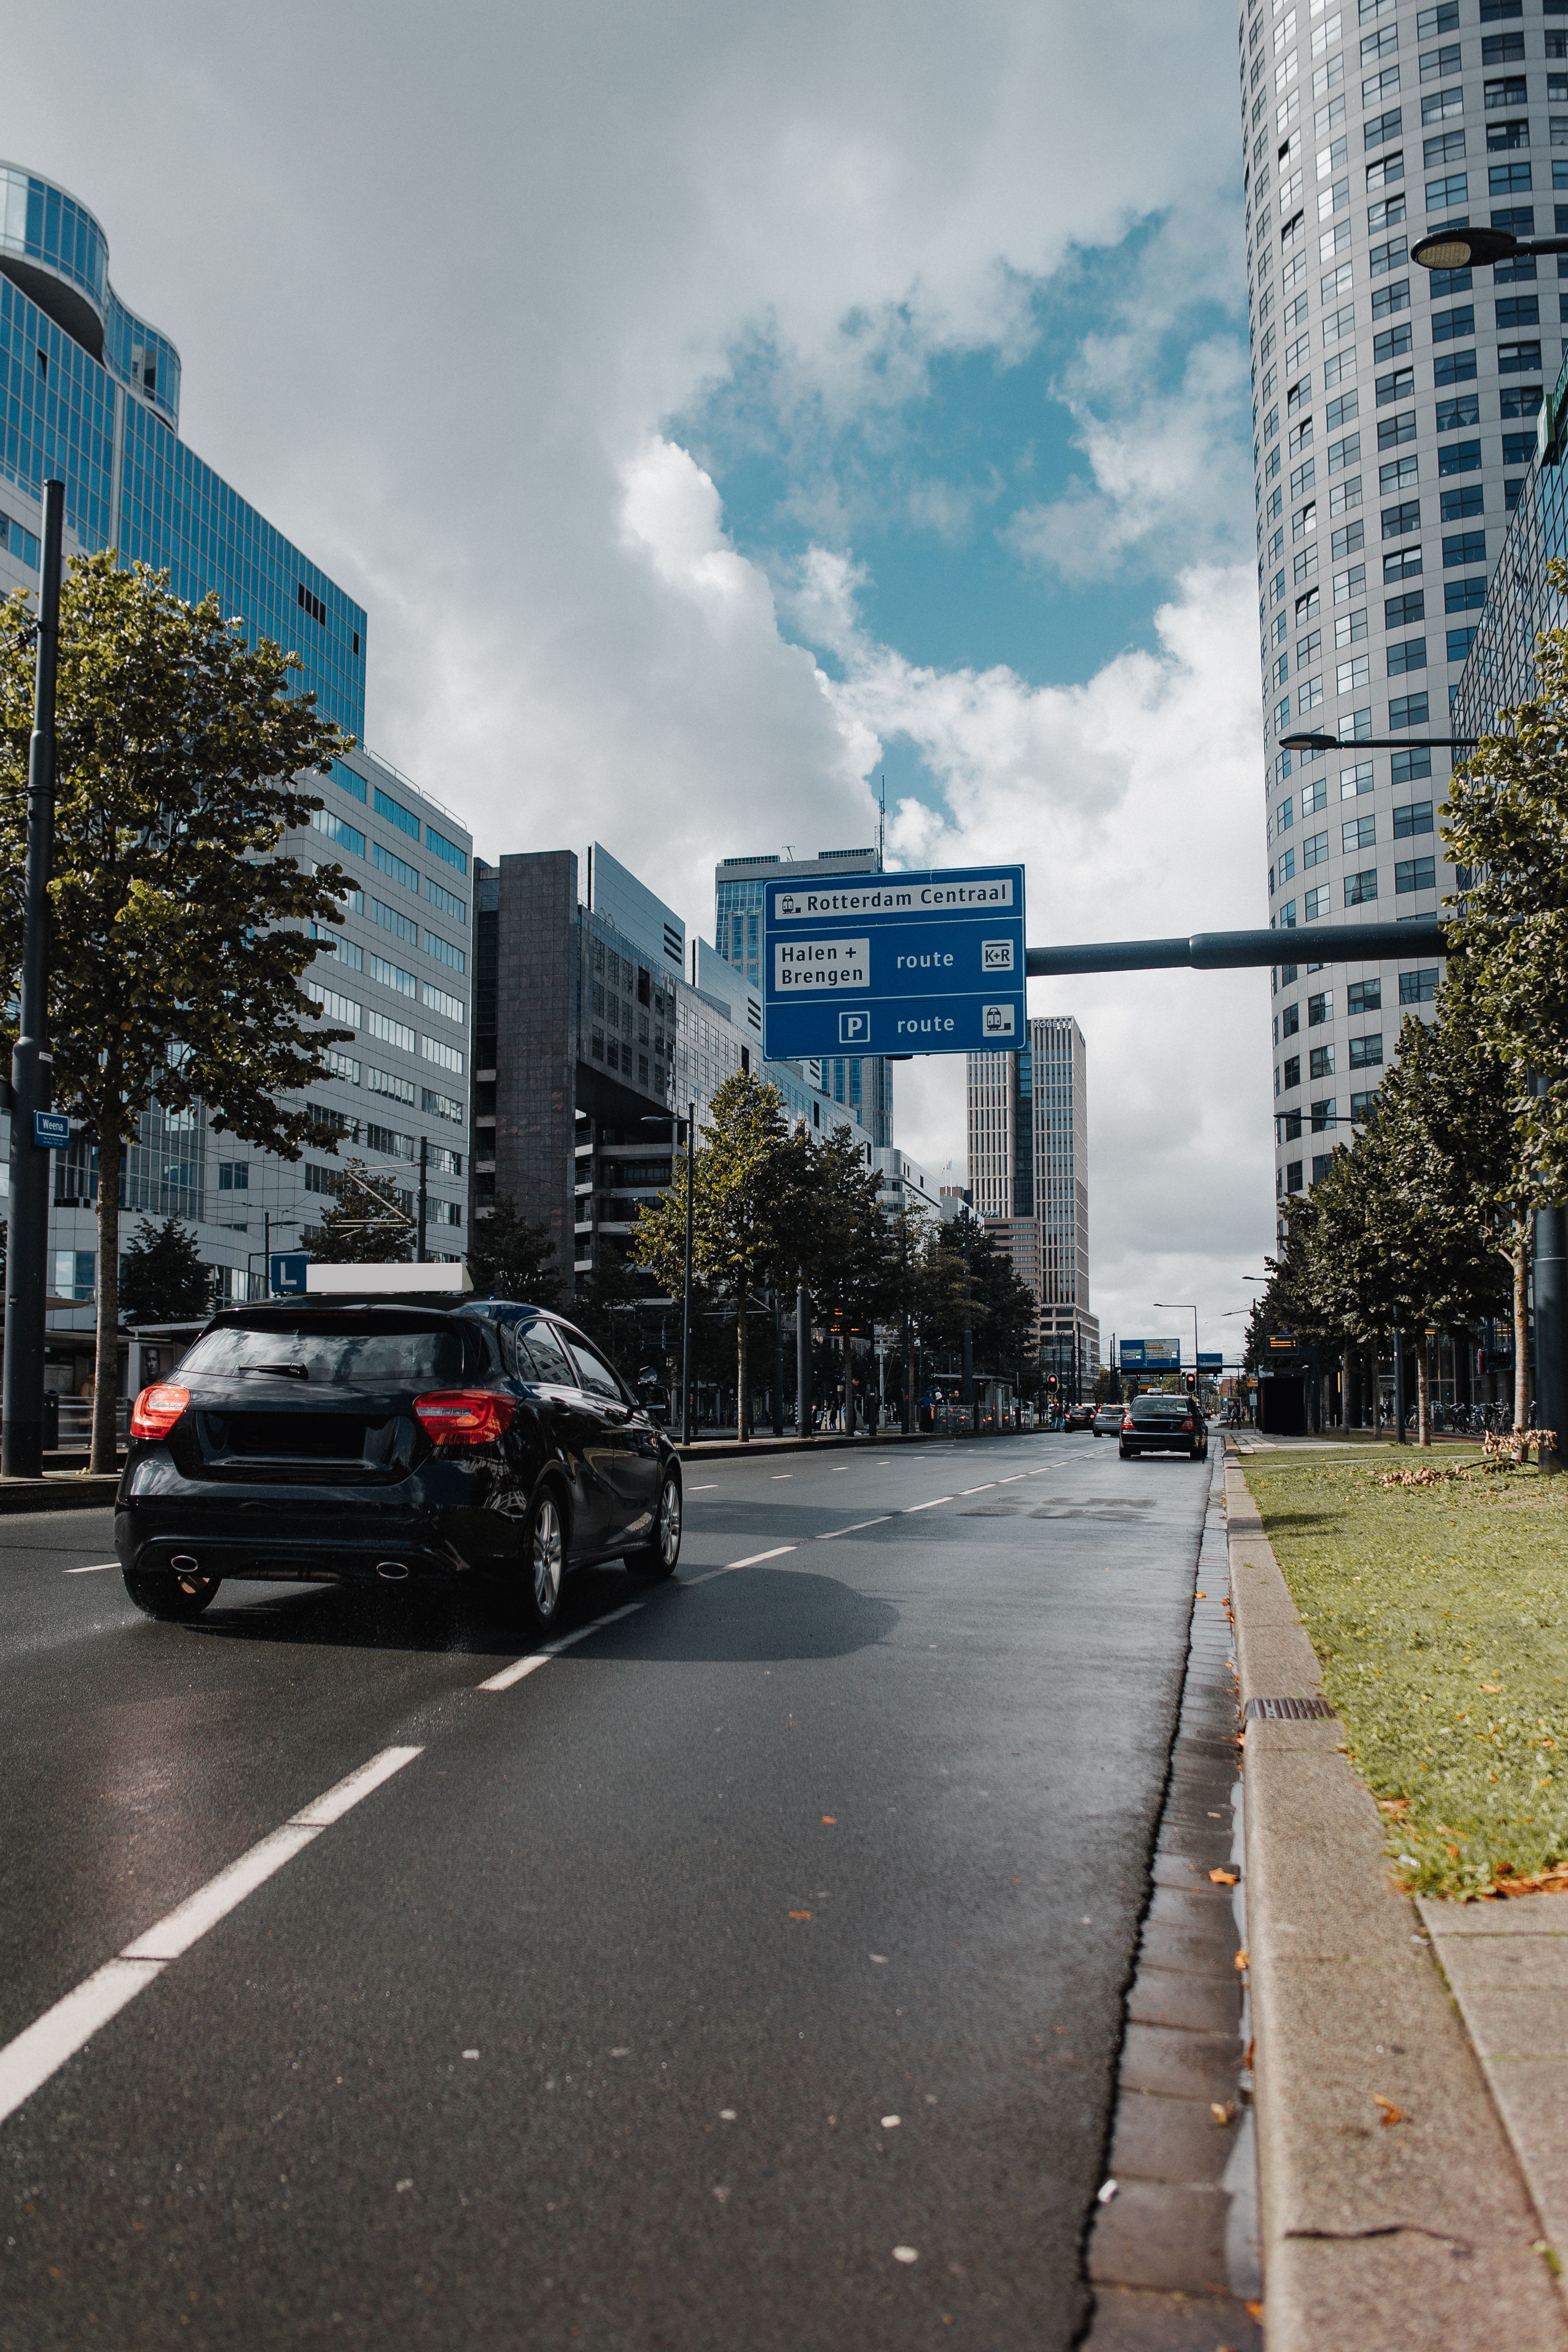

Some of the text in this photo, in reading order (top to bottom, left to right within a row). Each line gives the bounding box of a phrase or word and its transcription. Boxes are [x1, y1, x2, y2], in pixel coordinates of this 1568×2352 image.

[807, 884, 1006, 912] Rotterdam Centraal
[782, 946, 857, 962] Halen +
[897, 952, 954, 969] route
[985, 949, 1010, 963] K+R
[782, 969, 863, 986] Brengen
[848, 1017, 862, 1037] P
[898, 1016, 954, 1033] route
[1034, 1020, 1071, 1029] ROBECO
[42, 1118, 63, 1132] Weena
[281, 1262, 297, 1285] L
